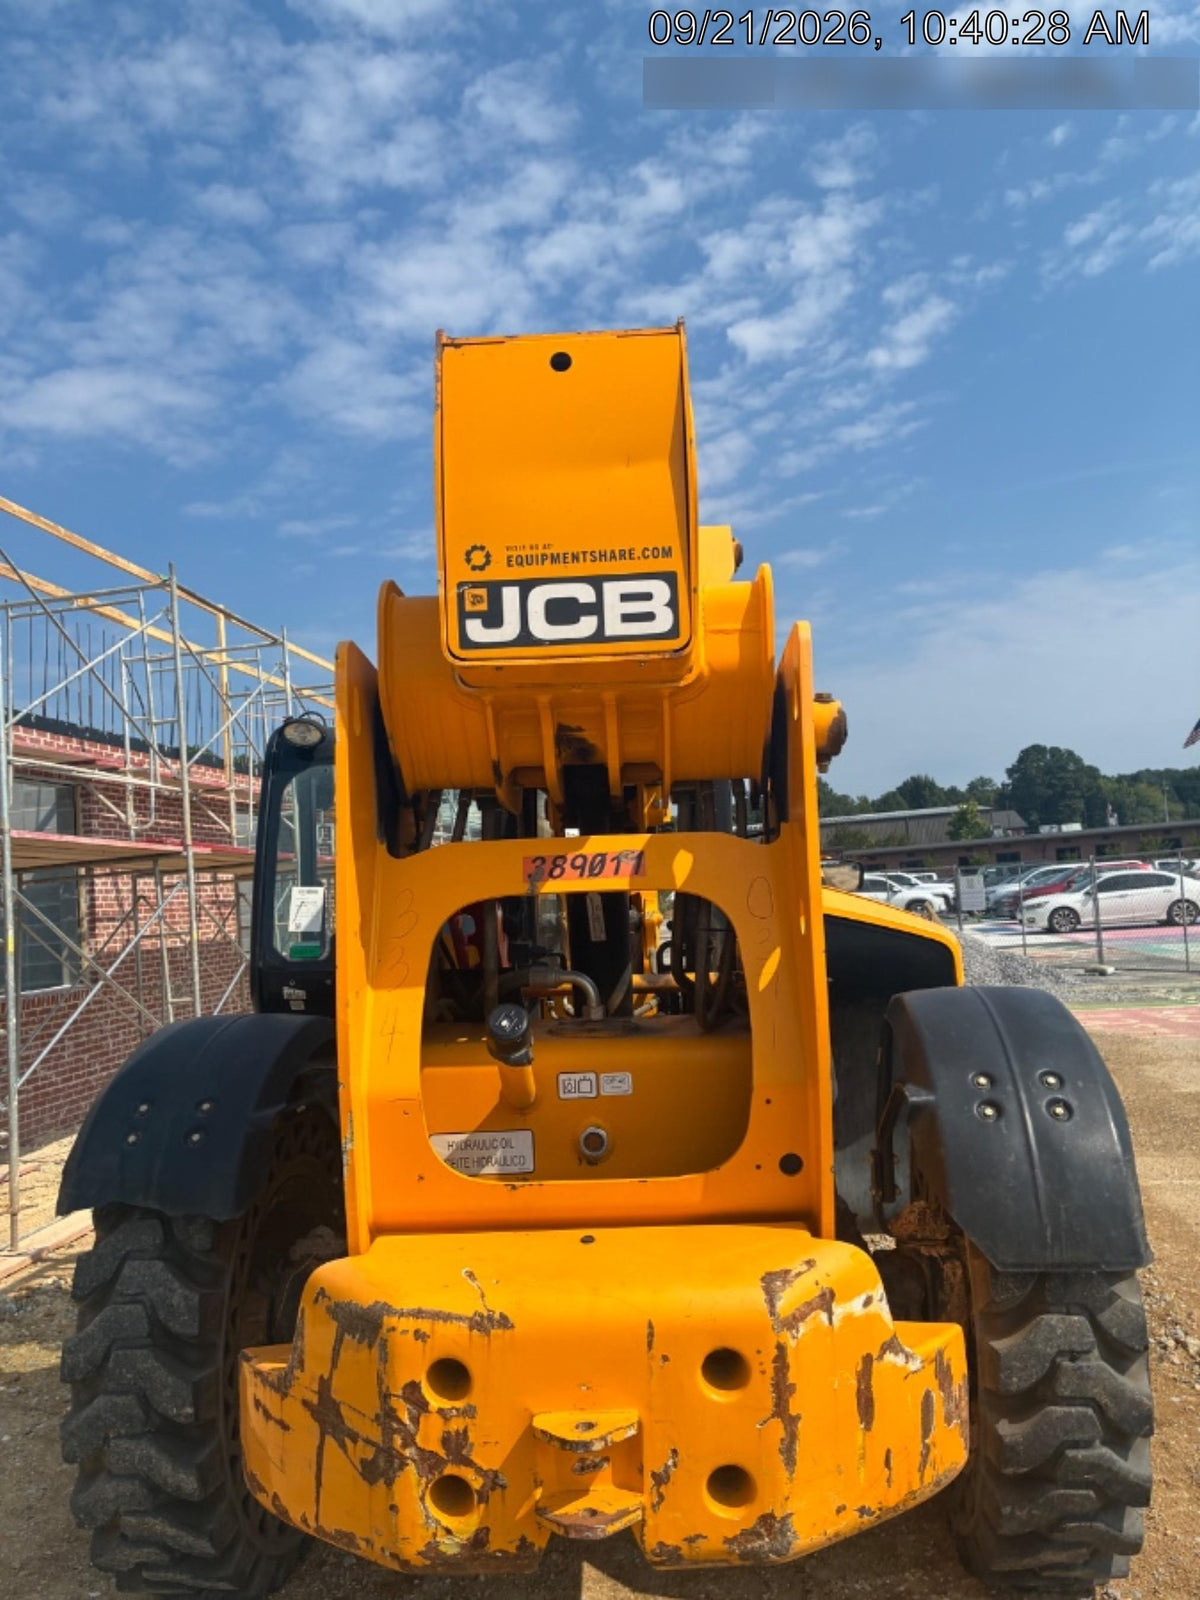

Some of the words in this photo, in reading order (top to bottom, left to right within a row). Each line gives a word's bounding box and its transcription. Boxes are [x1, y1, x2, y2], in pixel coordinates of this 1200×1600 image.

[506, 546, 673, 568] EQUIPMENTSHARE.COM
[465, 579, 674, 643] JCB
[448, 1138, 498, 1151] HYDRAULIC
[501, 1137, 514, 1149] OIL
